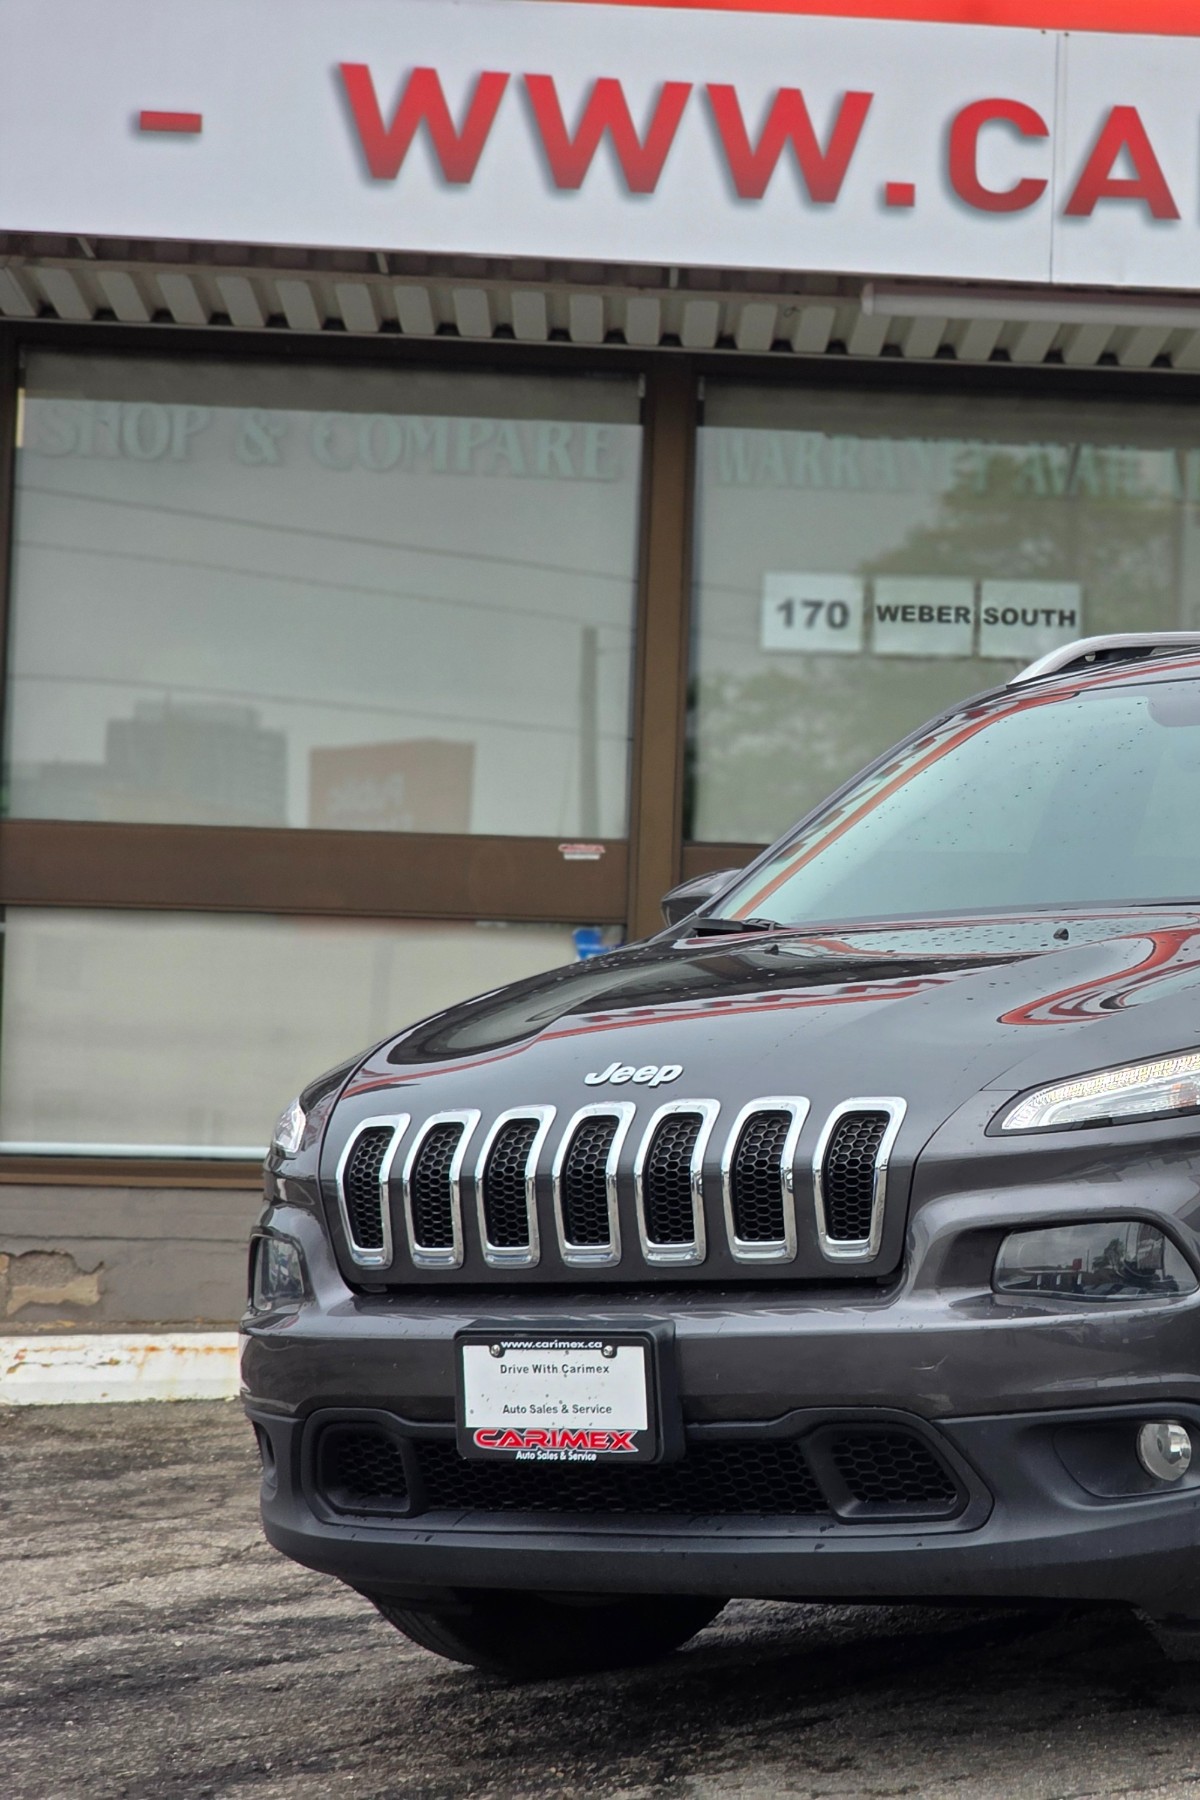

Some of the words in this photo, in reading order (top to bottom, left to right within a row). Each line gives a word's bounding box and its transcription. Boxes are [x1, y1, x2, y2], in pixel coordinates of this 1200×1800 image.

[37, 400, 211, 461] SHOP
[235, 407, 287, 467] &
[311, 411, 622, 482] COMPARE
[776, 599, 850, 630] 170
[875, 604, 972, 625] WEBER
[982, 606, 1077, 628] SOUTH
[583, 1061, 684, 1089] Jeep
[500, 1339, 603, 1349] www.carimex.ca
[500, 1364, 529, 1374] Drive
[532, 1363, 558, 1374] With
[561, 1364, 610, 1374] Carimex
[502, 1404, 527, 1414] Auto
[529, 1404, 557, 1414] Sales
[561, 1404, 570, 1414] &
[572, 1404, 612, 1414] Service
[474, 1428, 638, 1452] CARIMEX
[515, 1451, 536, 1461] Auto
[537, 1450, 559, 1461] Sales
[559, 1451, 567, 1461] &
[567, 1451, 597, 1461] Service
